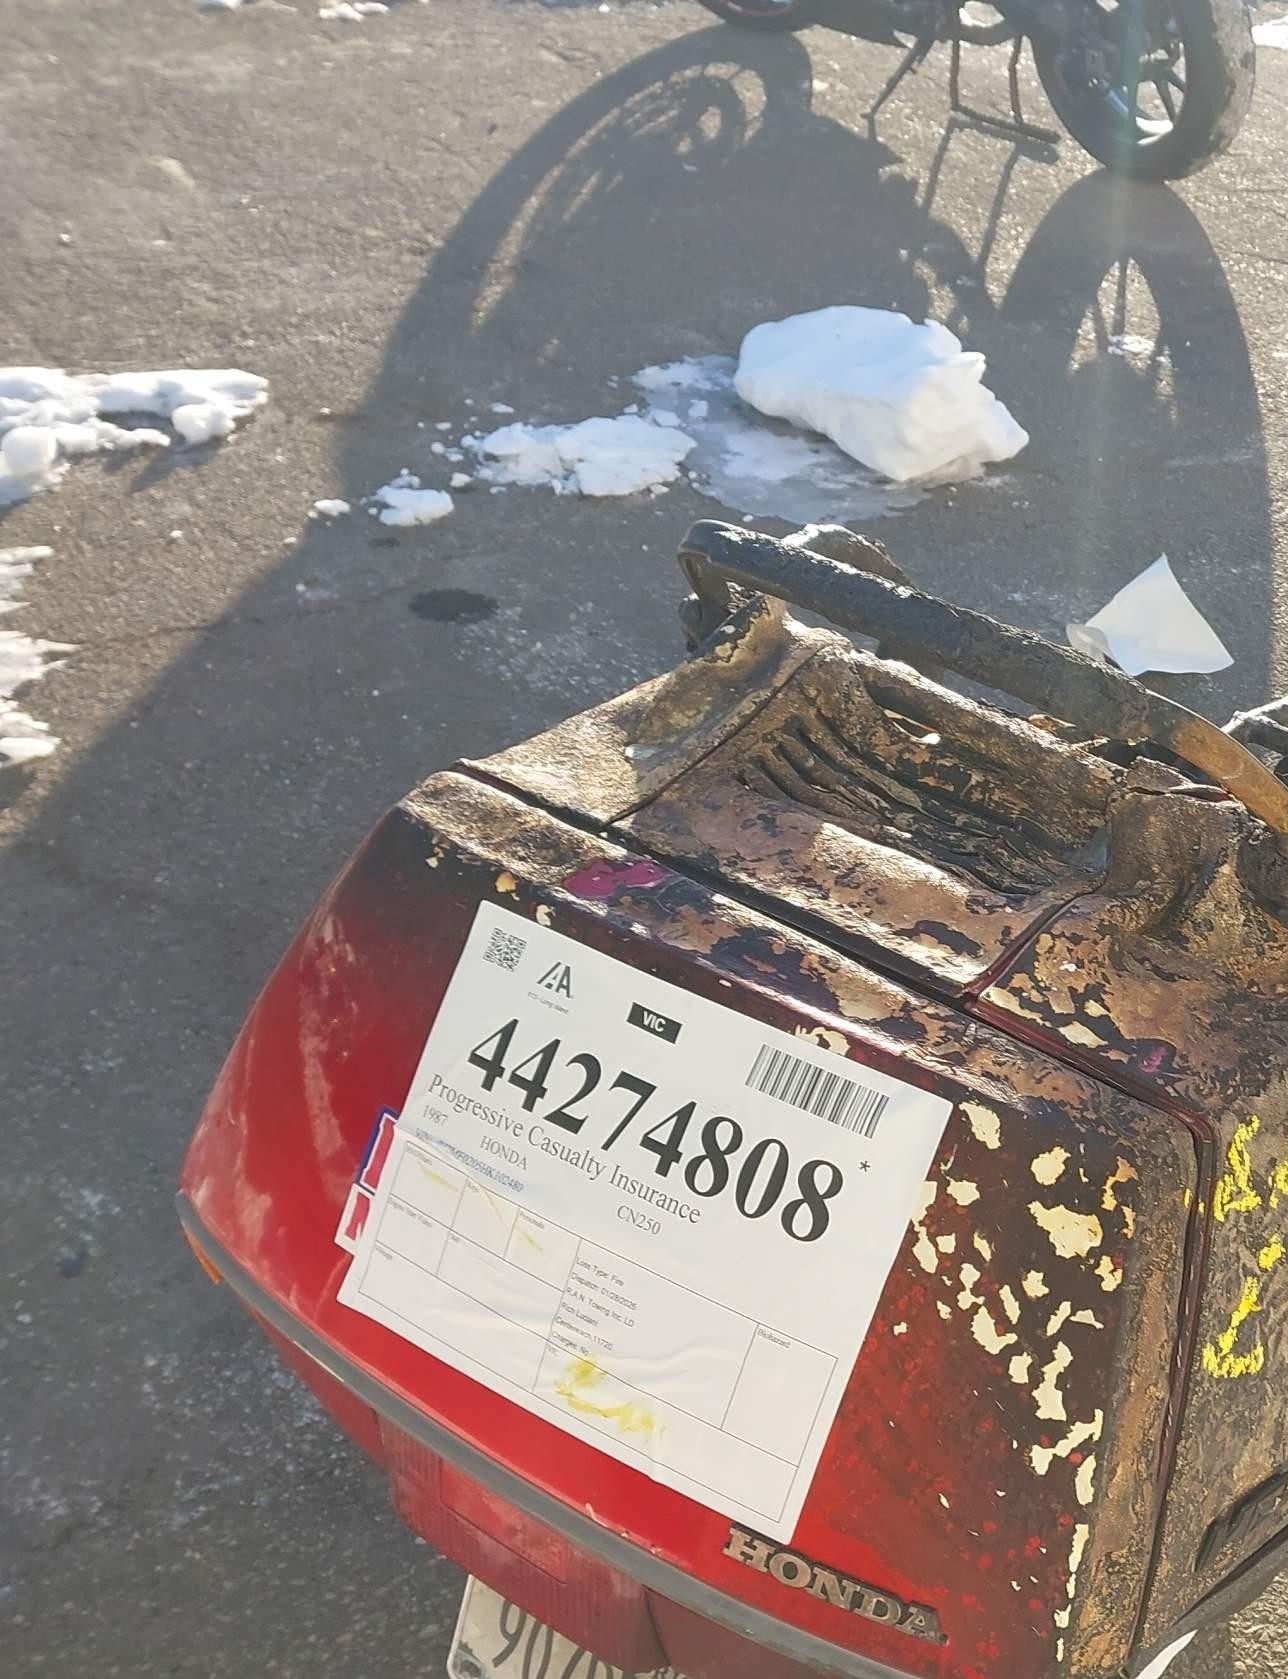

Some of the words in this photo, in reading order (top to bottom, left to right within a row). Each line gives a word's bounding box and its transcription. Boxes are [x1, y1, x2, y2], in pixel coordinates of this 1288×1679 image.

[642, 1010, 666, 1032] VIC
[421, 1104, 448, 1127] 1987
[479, 1135, 528, 1171] HONDA
[616, 1204, 662, 1236] CN250
[427, 1073, 525, 1138] Progressive
[527, 1125, 607, 1182] Casualty
[608, 1165, 702, 1224] Insurance
[467, 1018, 844, 1242] 44274808
[722, 1524, 949, 1646] HONDA
